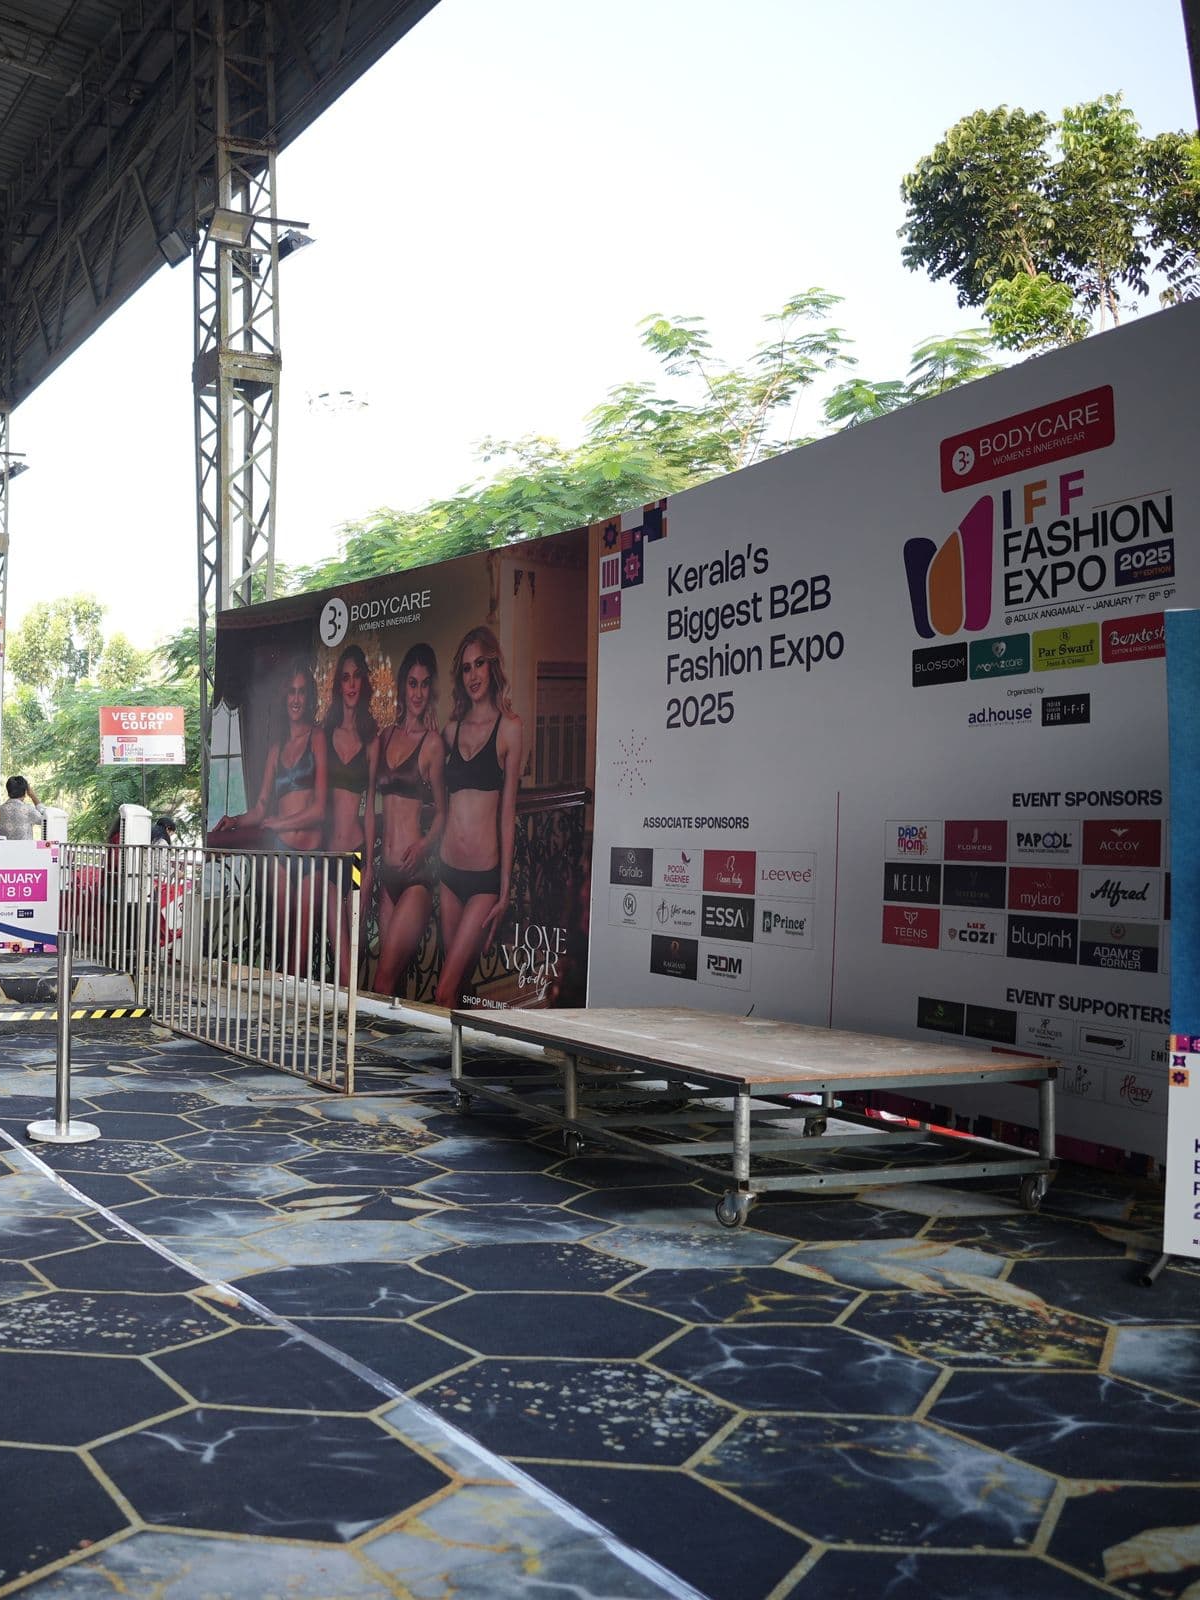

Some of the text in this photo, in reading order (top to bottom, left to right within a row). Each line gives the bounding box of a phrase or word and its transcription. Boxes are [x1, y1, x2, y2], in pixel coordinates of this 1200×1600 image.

[979, 402, 1100, 457] BODYCARE
[992, 431, 1085, 467] WOMEN'S INNERWEAR
[1003, 495, 1174, 568] FASHION
[667, 543, 769, 597] Kerala's
[1004, 546, 1171, 607] EXPO 2025
[351, 590, 432, 622] BODYCARE
[667, 574, 832, 644] Biggest B2B
[1013, 609, 1039, 623] ADLUX
[1040, 604, 1085, 619] ANGAMALY
[1093, 595, 1132, 611] JANUARY
[358, 613, 422, 632] WOMEN'S INNERWEAR
[667, 630, 844, 685] Fashion Expo
[1038, 646, 1057, 659] Par
[915, 657, 965, 673] BLOSSOM
[111, 712, 173, 721] VEG FOOD
[666, 690, 735, 729] 2025
[968, 706, 1033, 724] ad.house
[122, 721, 163, 730] COURT
[1012, 789, 1162, 807] EVENT SPONSORS
[643, 816, 750, 829] ASSOCIATE SPONSORS
[957, 843, 992, 851] FLOWERS
[1017, 831, 1072, 849] PAPOOL
[1099, 841, 1139, 851] ACCOY
[893, 873, 931, 892] NELLY
[1020, 891, 1061, 908] mylaro
[1090, 879, 1150, 908] Alfred
[705, 906, 745, 929] ESSA
[773, 913, 804, 931] Prince
[511, 923, 567, 955] LOVE
[894, 926, 928, 939] TEENS
[959, 930, 995, 944] COZI
[501, 944, 559, 977] YOUR
[1093, 947, 1141, 961] ADAM'S
[1100, 958, 1141, 970] CORNER
[518, 962, 552, 1000] body
[462, 995, 481, 1007] SHOP
[482, 998, 508, 1010] ONLINE
[1006, 987, 1170, 1025] EVENT SUPPORTERS
